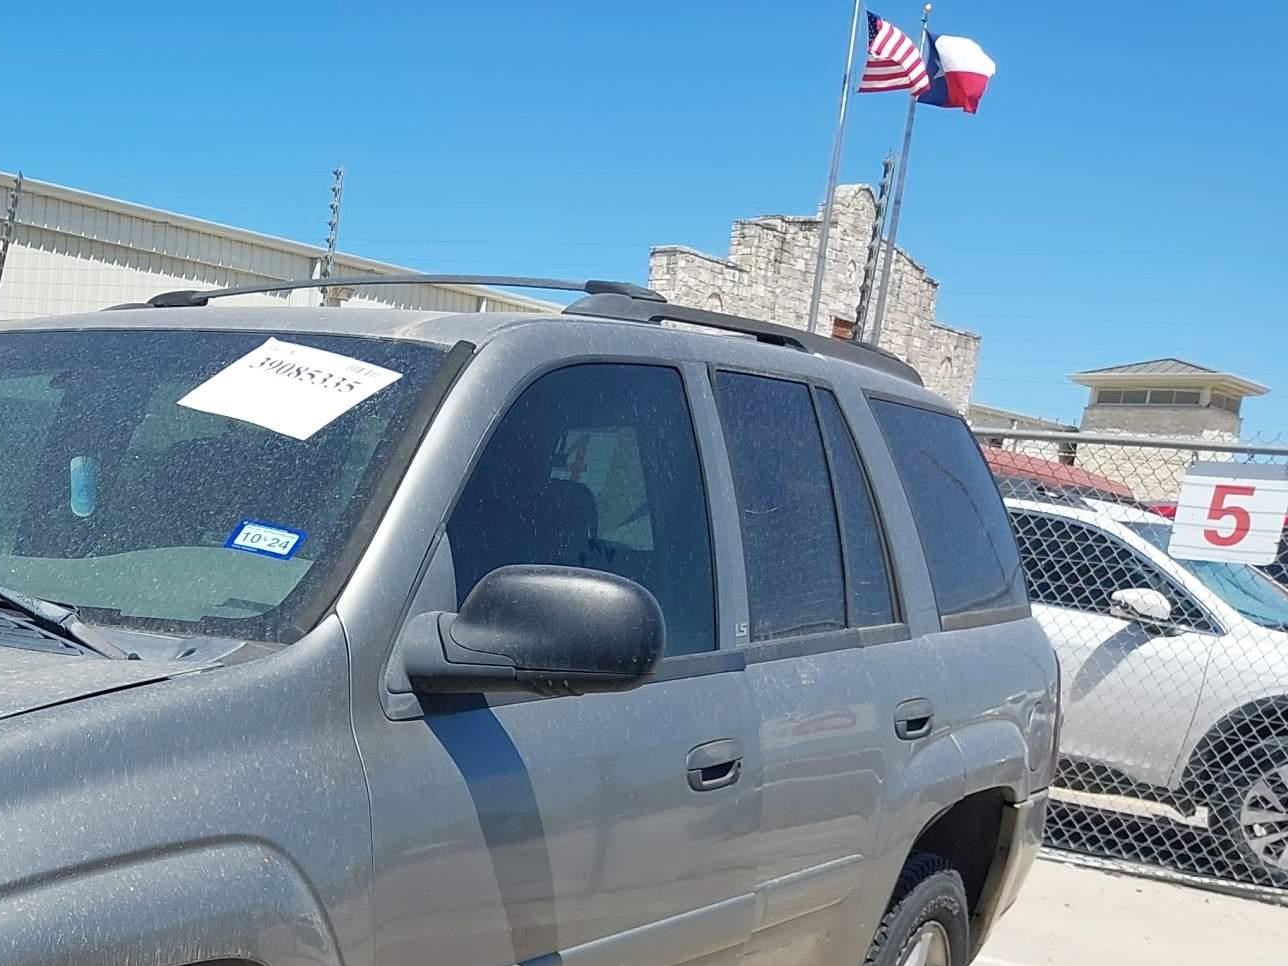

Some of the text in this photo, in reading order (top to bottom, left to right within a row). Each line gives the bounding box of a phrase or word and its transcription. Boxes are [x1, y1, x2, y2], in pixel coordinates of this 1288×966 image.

[249, 356, 362, 392] 39085335
[1202, 484, 1256, 547] 5
[735, 623, 748, 637] LS
